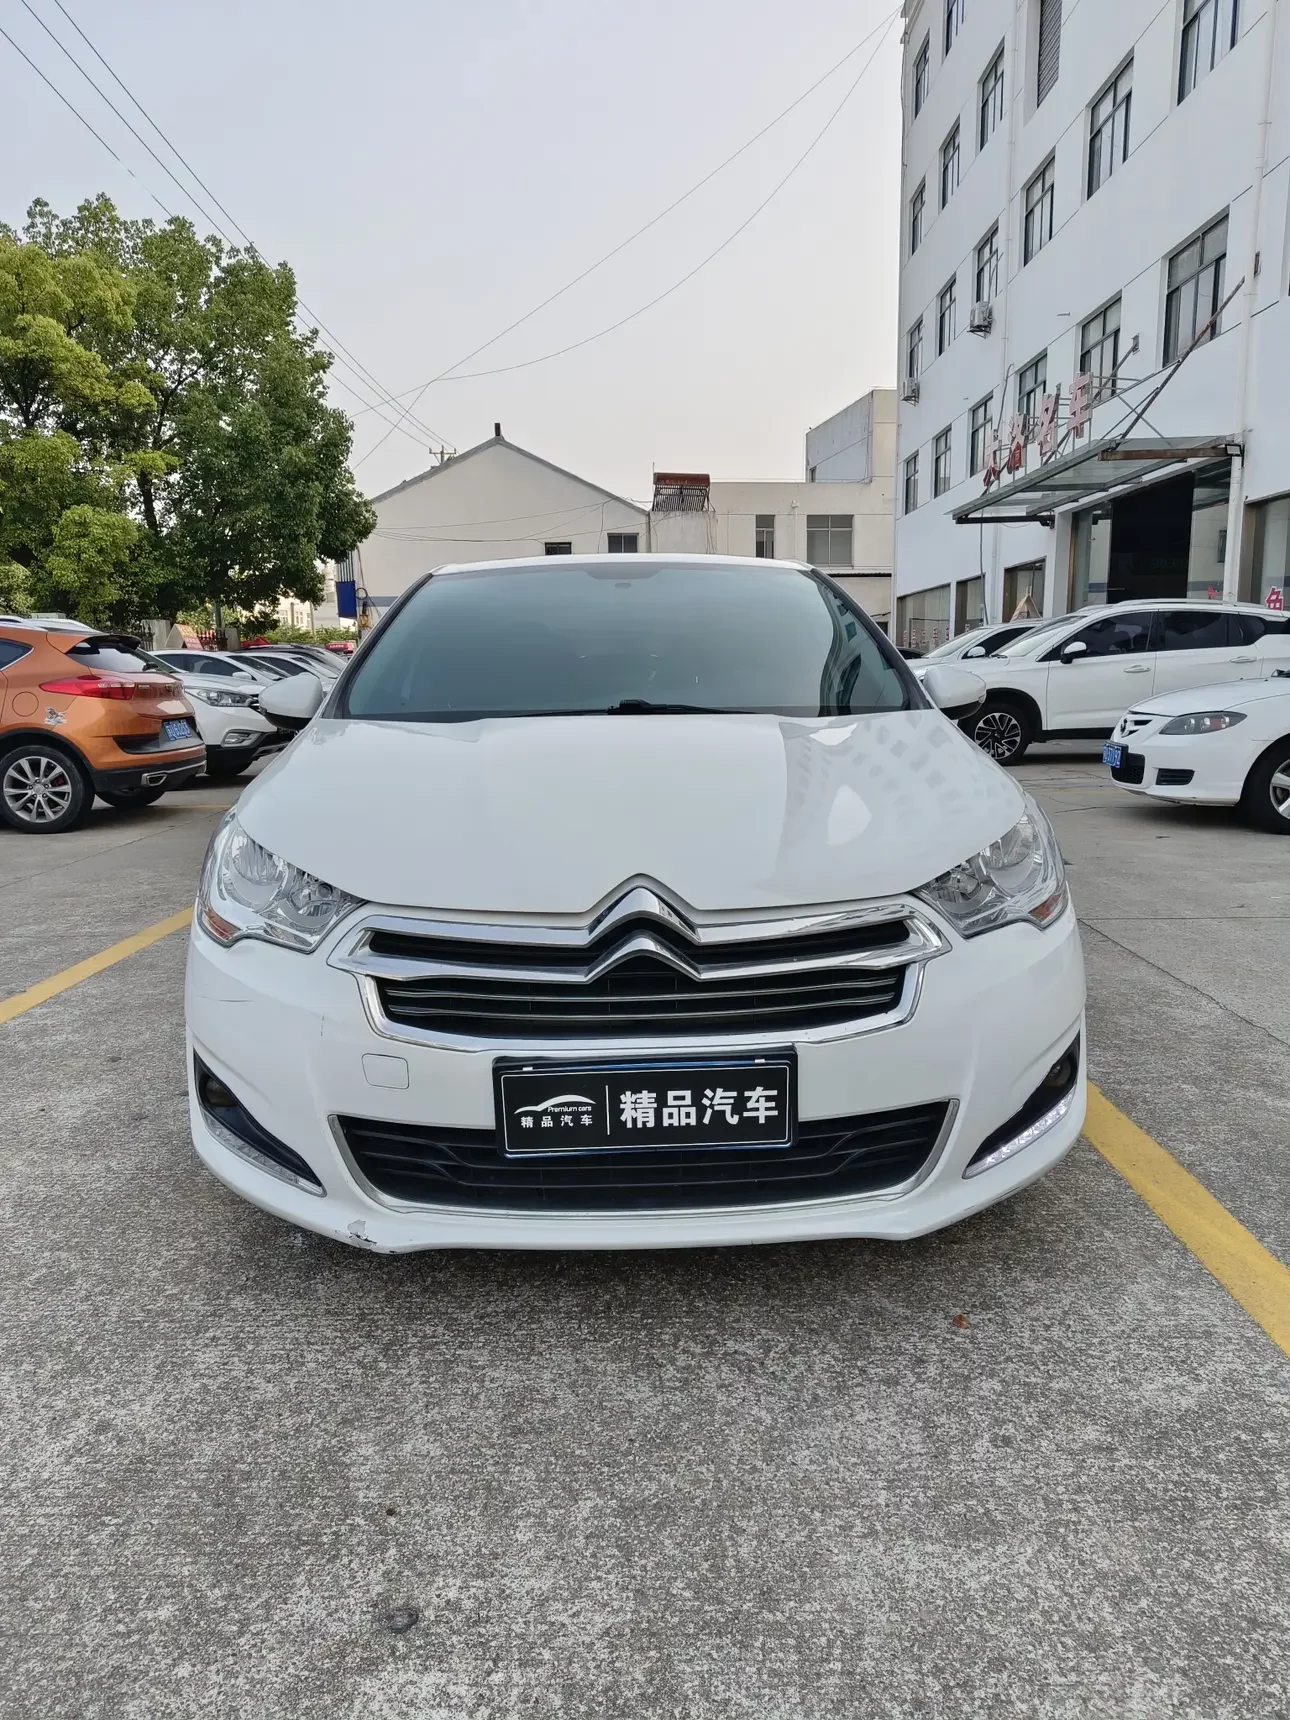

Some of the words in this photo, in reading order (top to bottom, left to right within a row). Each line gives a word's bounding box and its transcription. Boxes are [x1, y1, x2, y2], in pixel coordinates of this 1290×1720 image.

[520, 1114, 593, 1128] 精品汽车
[619, 1086, 779, 1129] 精品汽车
